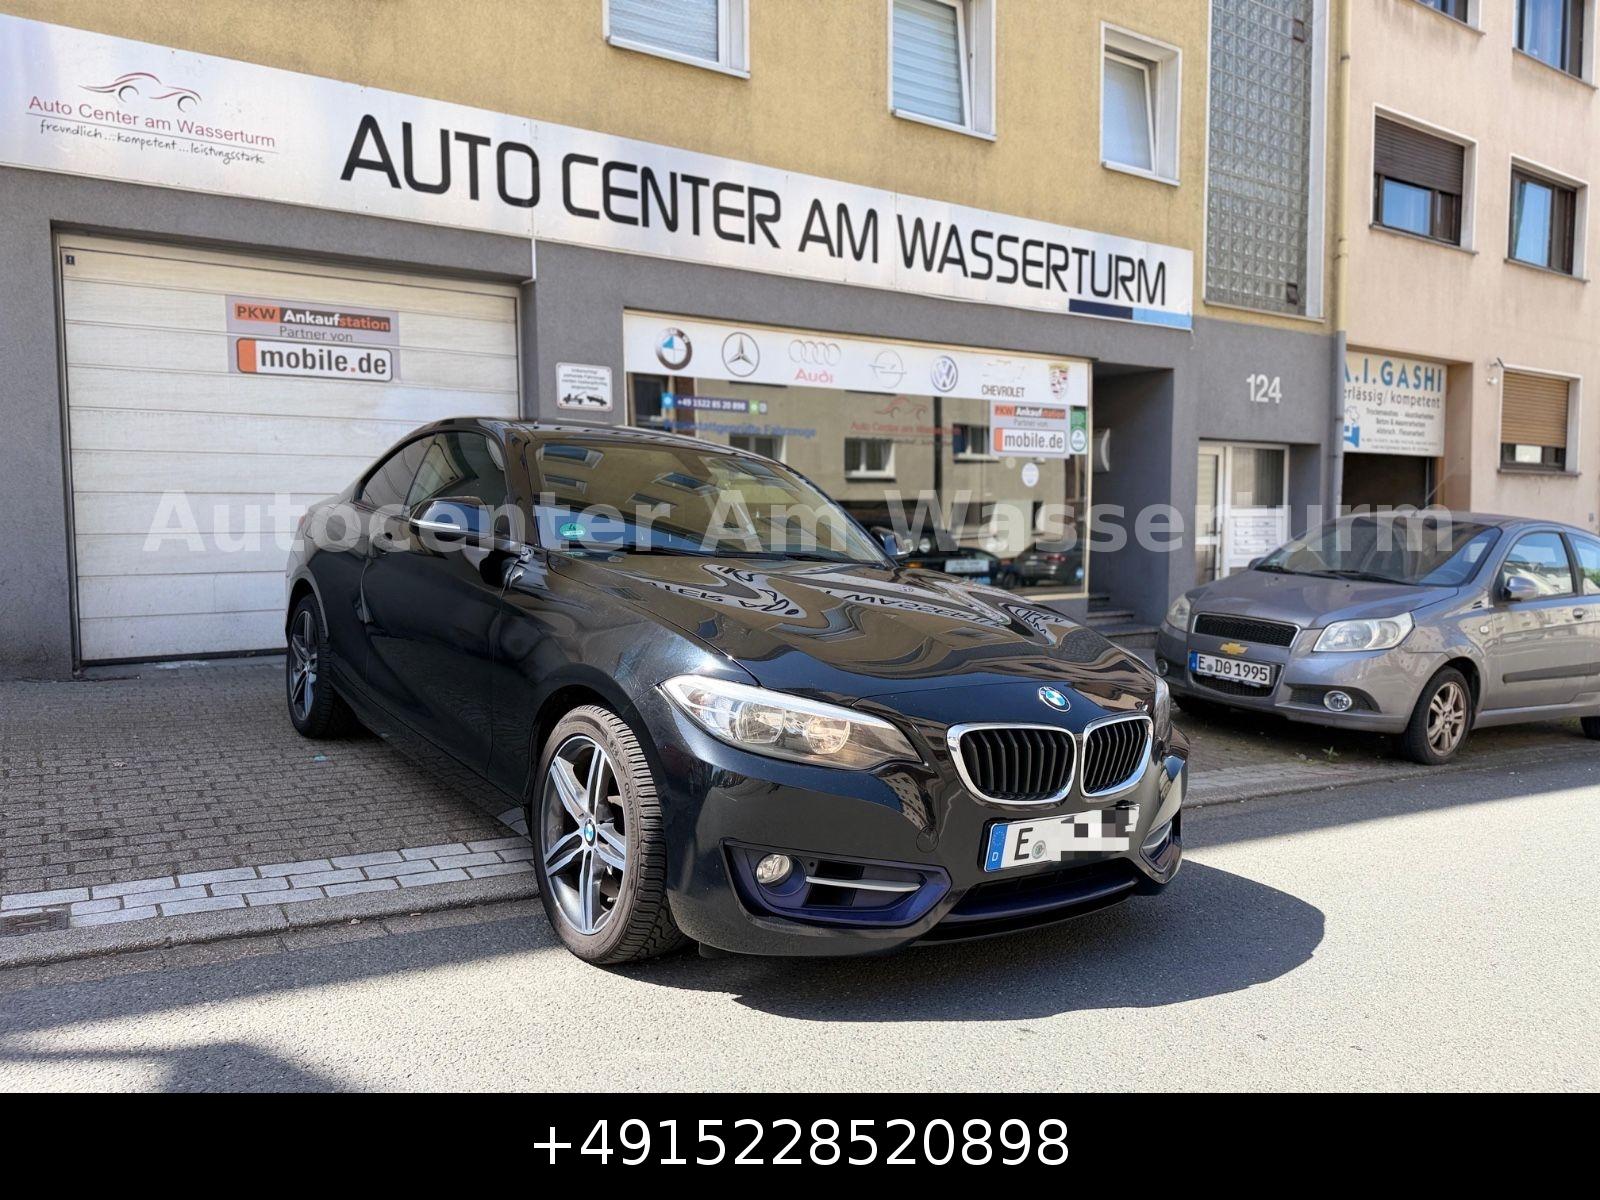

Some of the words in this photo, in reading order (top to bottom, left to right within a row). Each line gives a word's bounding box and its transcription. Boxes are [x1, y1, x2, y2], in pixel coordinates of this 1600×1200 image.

[28, 95, 72, 116] Auto
[78, 104, 140, 126] Center
[144, 119, 172, 132] am
[176, 119, 276, 148] Wasserturm
[340, 113, 541, 209] AUTO
[562, 153, 782, 249] CENTER
[798, 198, 879, 264] AM
[896, 213, 1166, 306] WASSERTURM
[237, 305, 276, 320] PKW
[283, 309, 390, 331] Ankaufstation
[279, 325, 327, 340] Partner
[330, 332, 353, 342] von
[261, 347, 387, 375] mobile.de
[794, 368, 834, 384] Audi
[981, 384, 1025, 398] CHEVROLET
[1246, 373, 1282, 404] 124
[1390, 391, 1440, 409] kompetent
[1005, 432, 1064, 449] mobile.de
[1199, 656, 1206, 670] E
[1014, 826, 1034, 861] E
